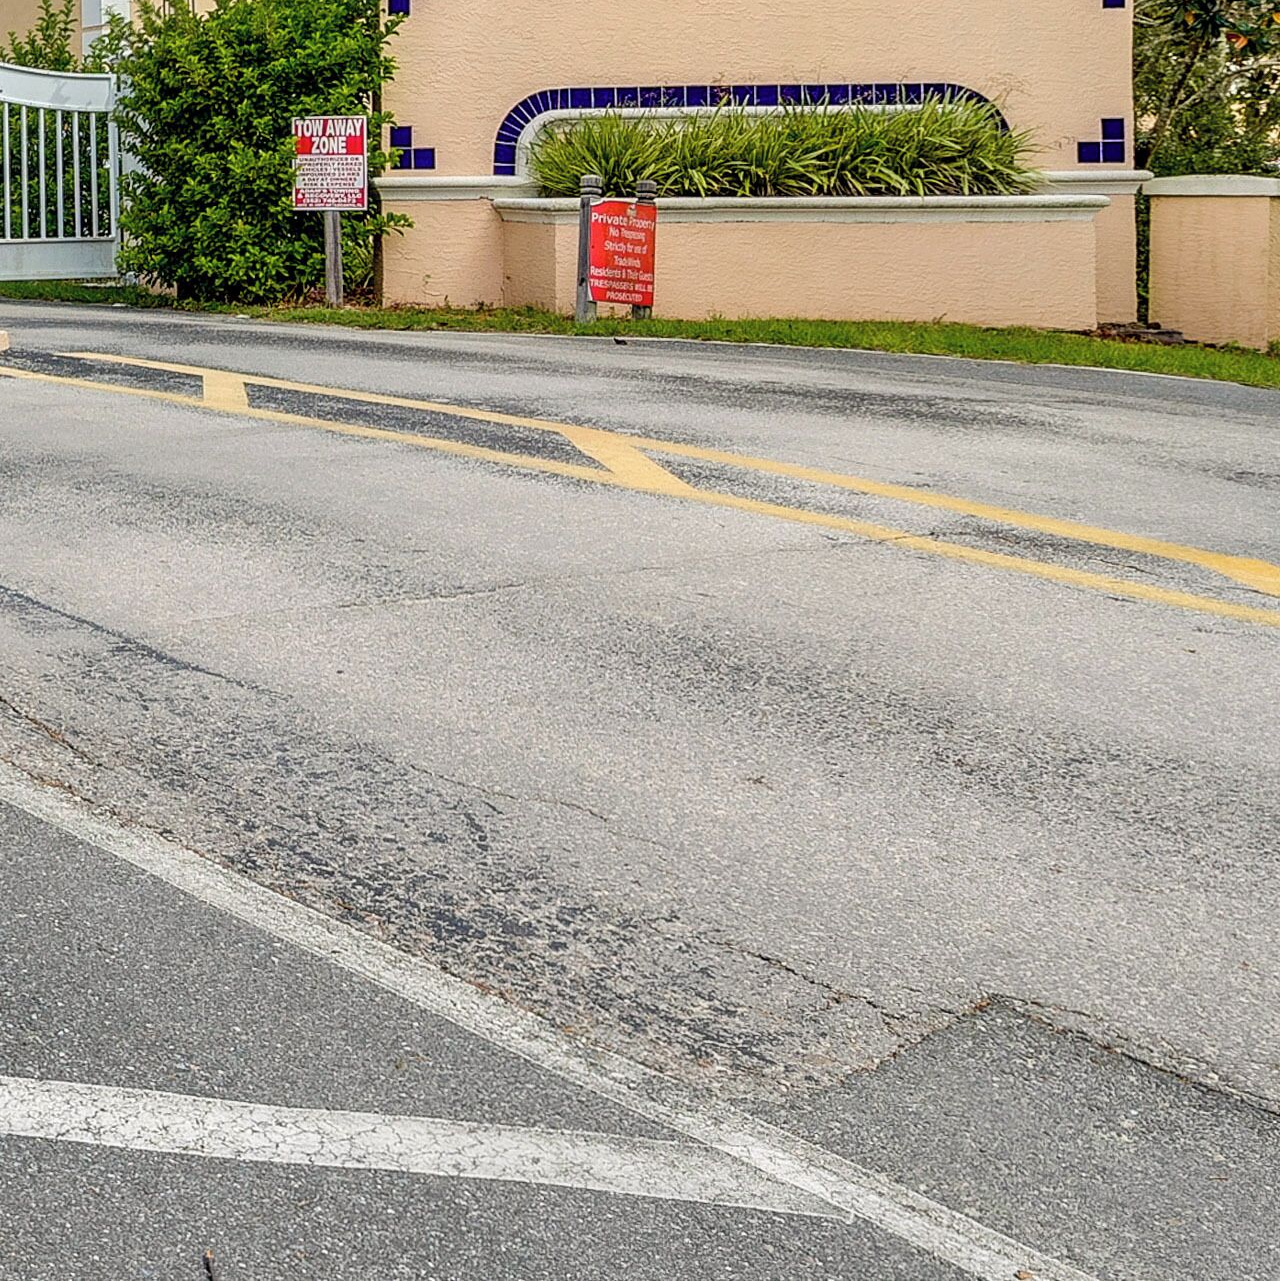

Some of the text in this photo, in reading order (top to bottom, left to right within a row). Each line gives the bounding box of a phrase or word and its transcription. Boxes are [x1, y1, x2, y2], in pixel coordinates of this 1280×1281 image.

[295, 119, 362, 137] TOW AWAY
[311, 136, 347, 154] ZONE
[591, 212, 655, 231] Private Property
[609, 226, 620, 237] No
[590, 266, 621, 278] Residents
[606, 291, 643, 302] PROSECUTED
